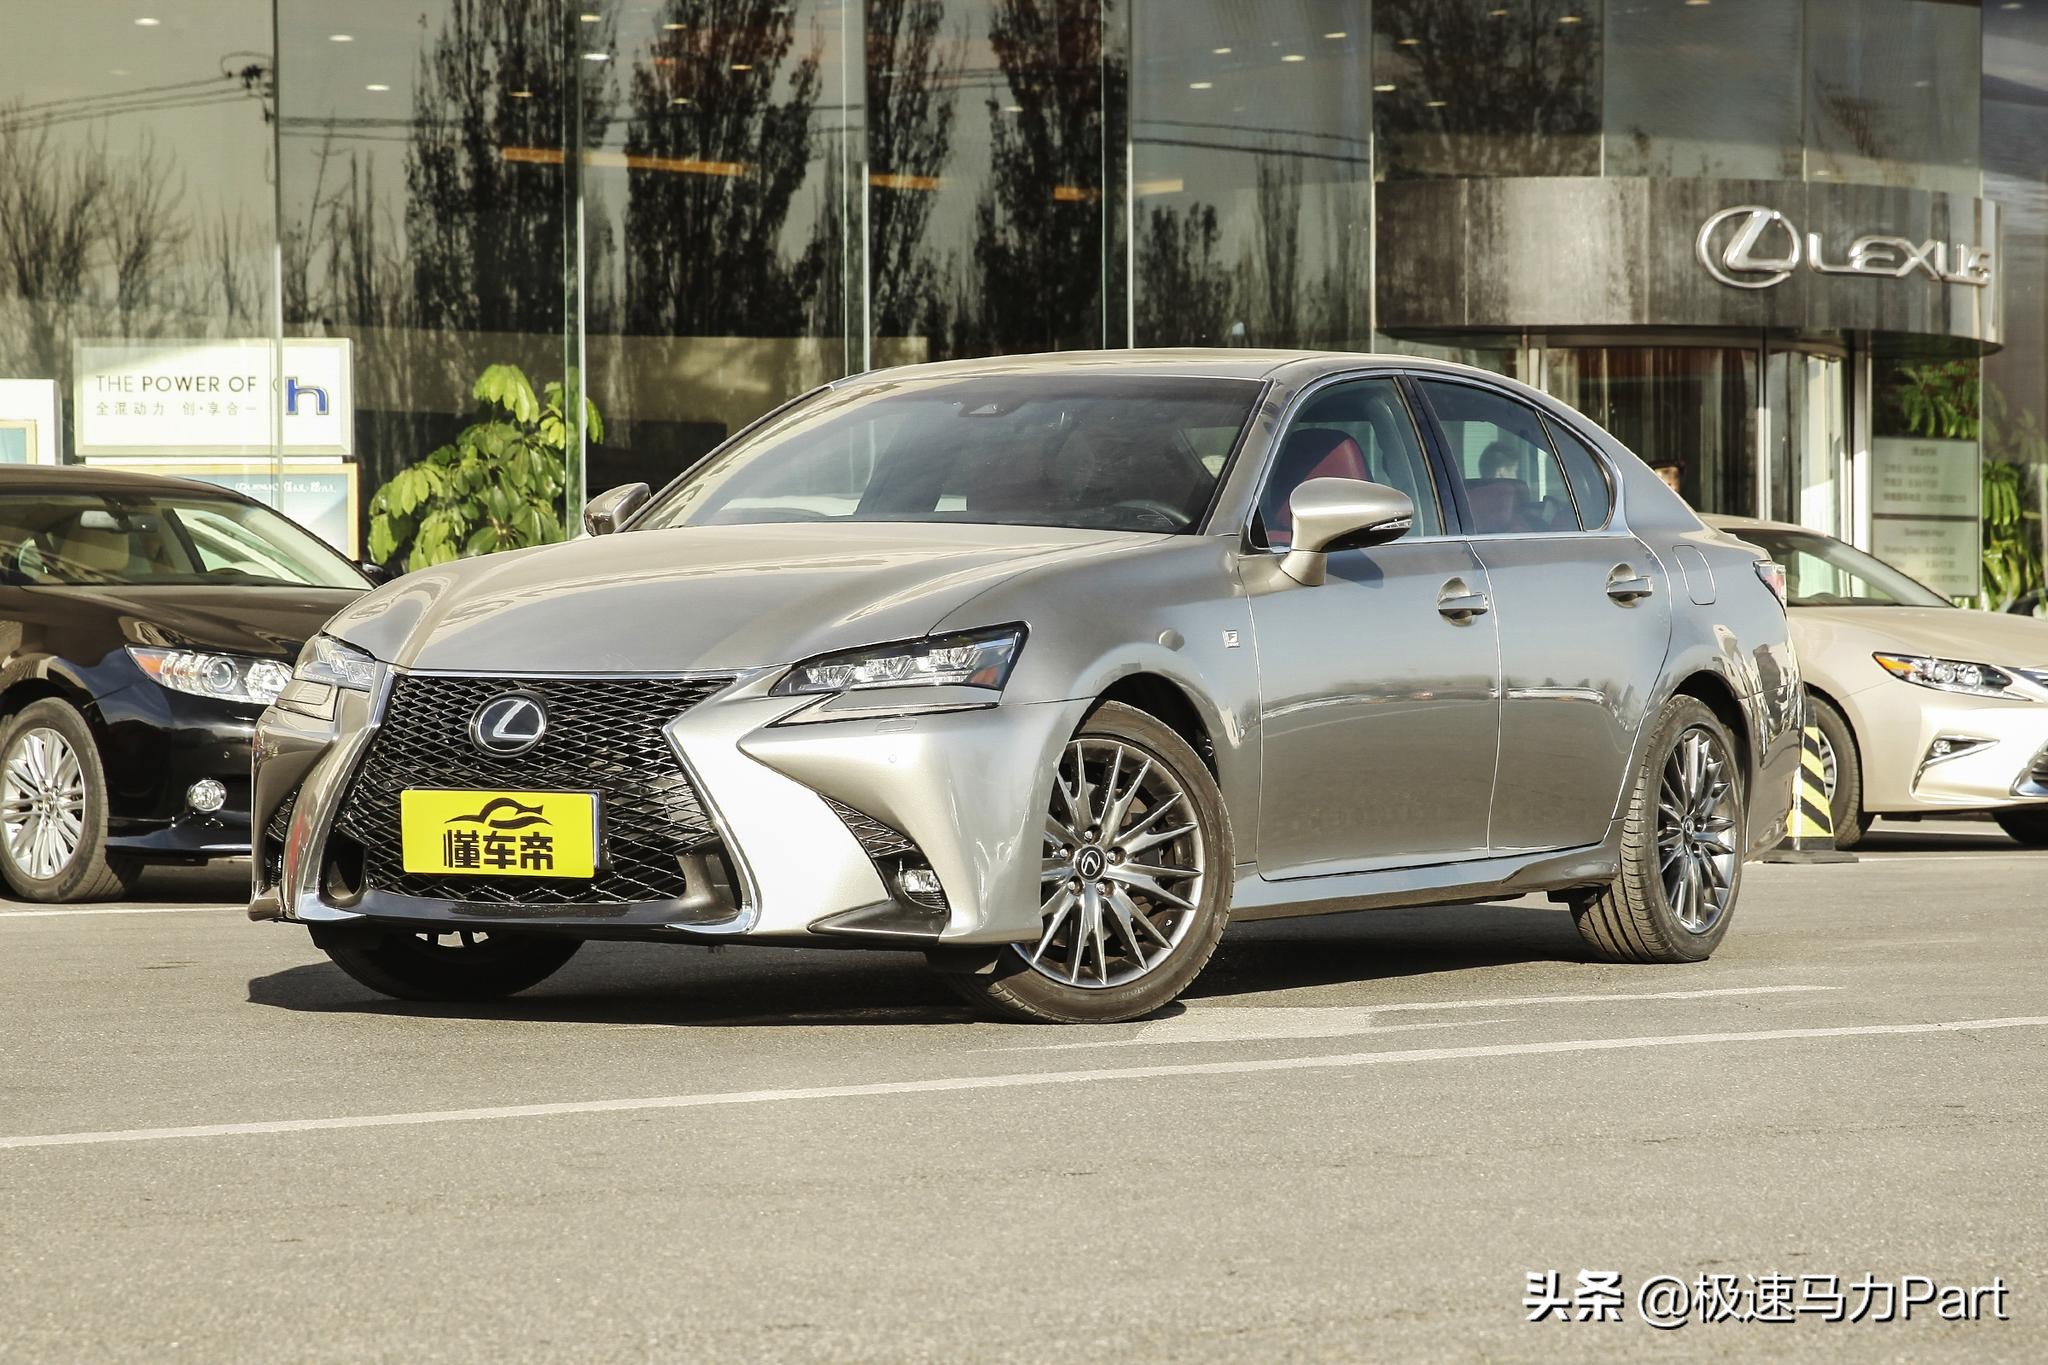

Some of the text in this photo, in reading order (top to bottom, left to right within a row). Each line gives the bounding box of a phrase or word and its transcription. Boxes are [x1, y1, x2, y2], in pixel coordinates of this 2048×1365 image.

[1807, 232, 1992, 286] LEXUS
[96, 375, 133, 392] THE
[142, 375, 220, 392] POWER
[228, 375, 257, 392] OF
[96, 402, 164, 416] 全混动力
[443, 829, 553, 870] 懂车帝
